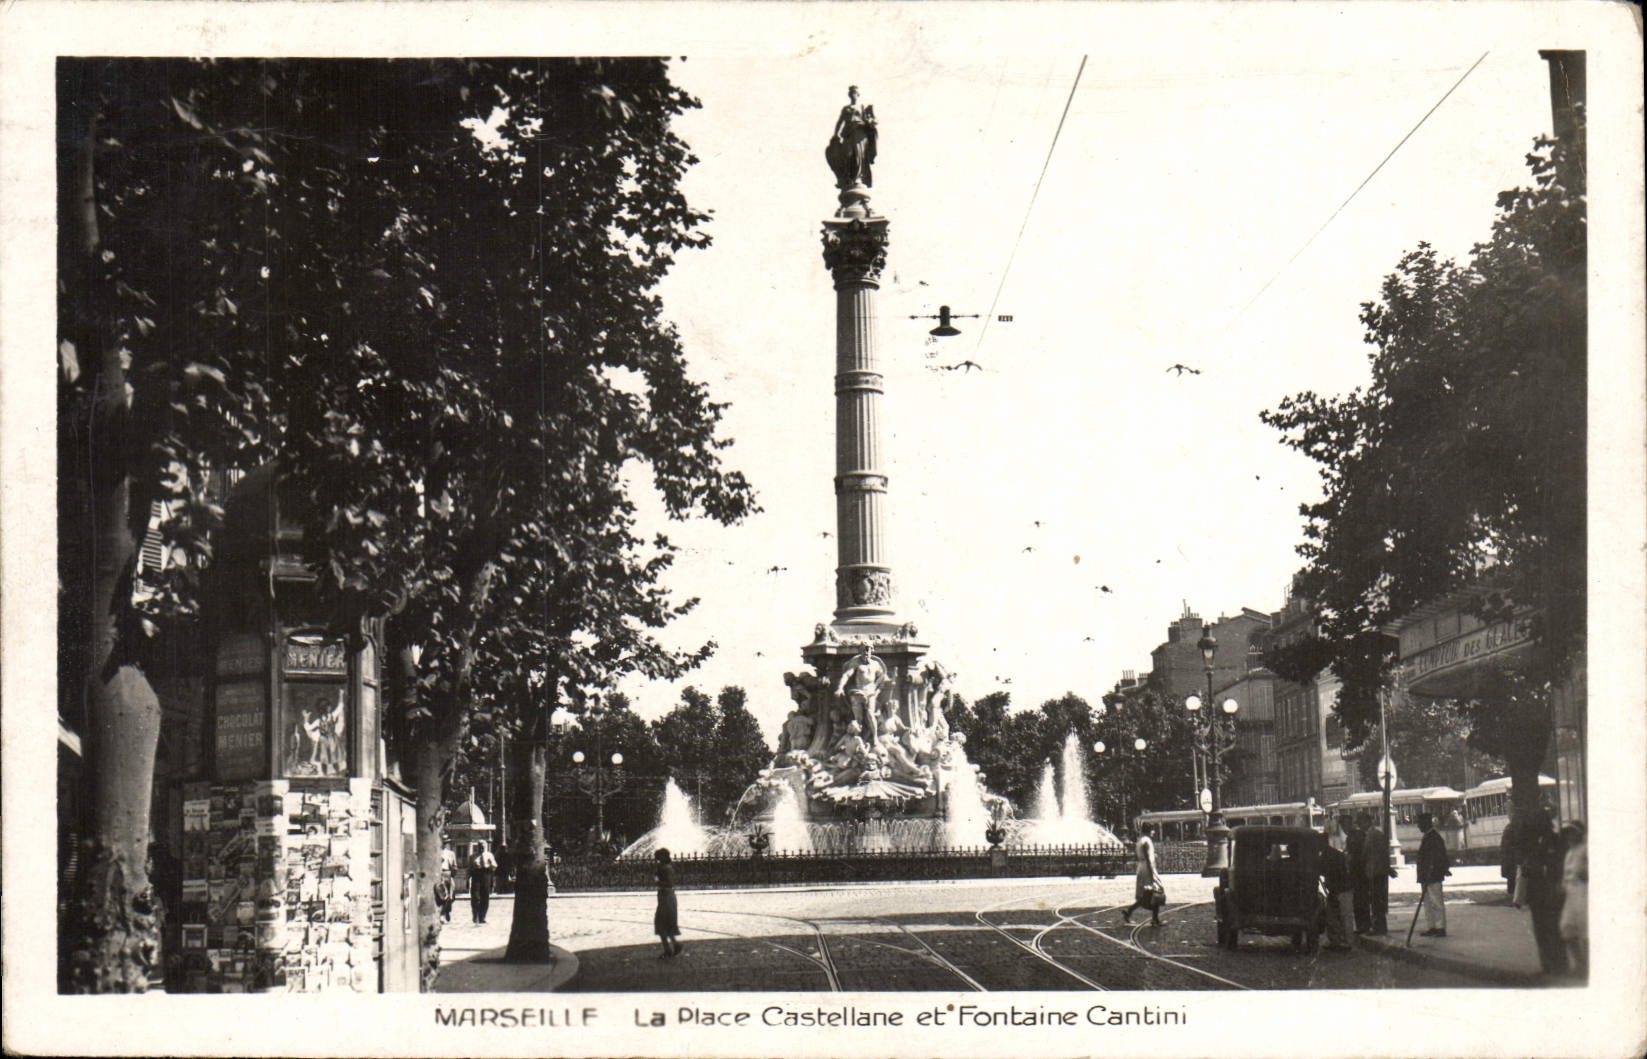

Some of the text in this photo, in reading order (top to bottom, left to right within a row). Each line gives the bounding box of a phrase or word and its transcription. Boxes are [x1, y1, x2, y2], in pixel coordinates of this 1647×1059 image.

[1464, 640, 1481, 658] DES
[287, 651, 346, 669] MENIER
[217, 712, 264, 729] CHOCOLAT
[217, 732, 264, 750] MENIER
